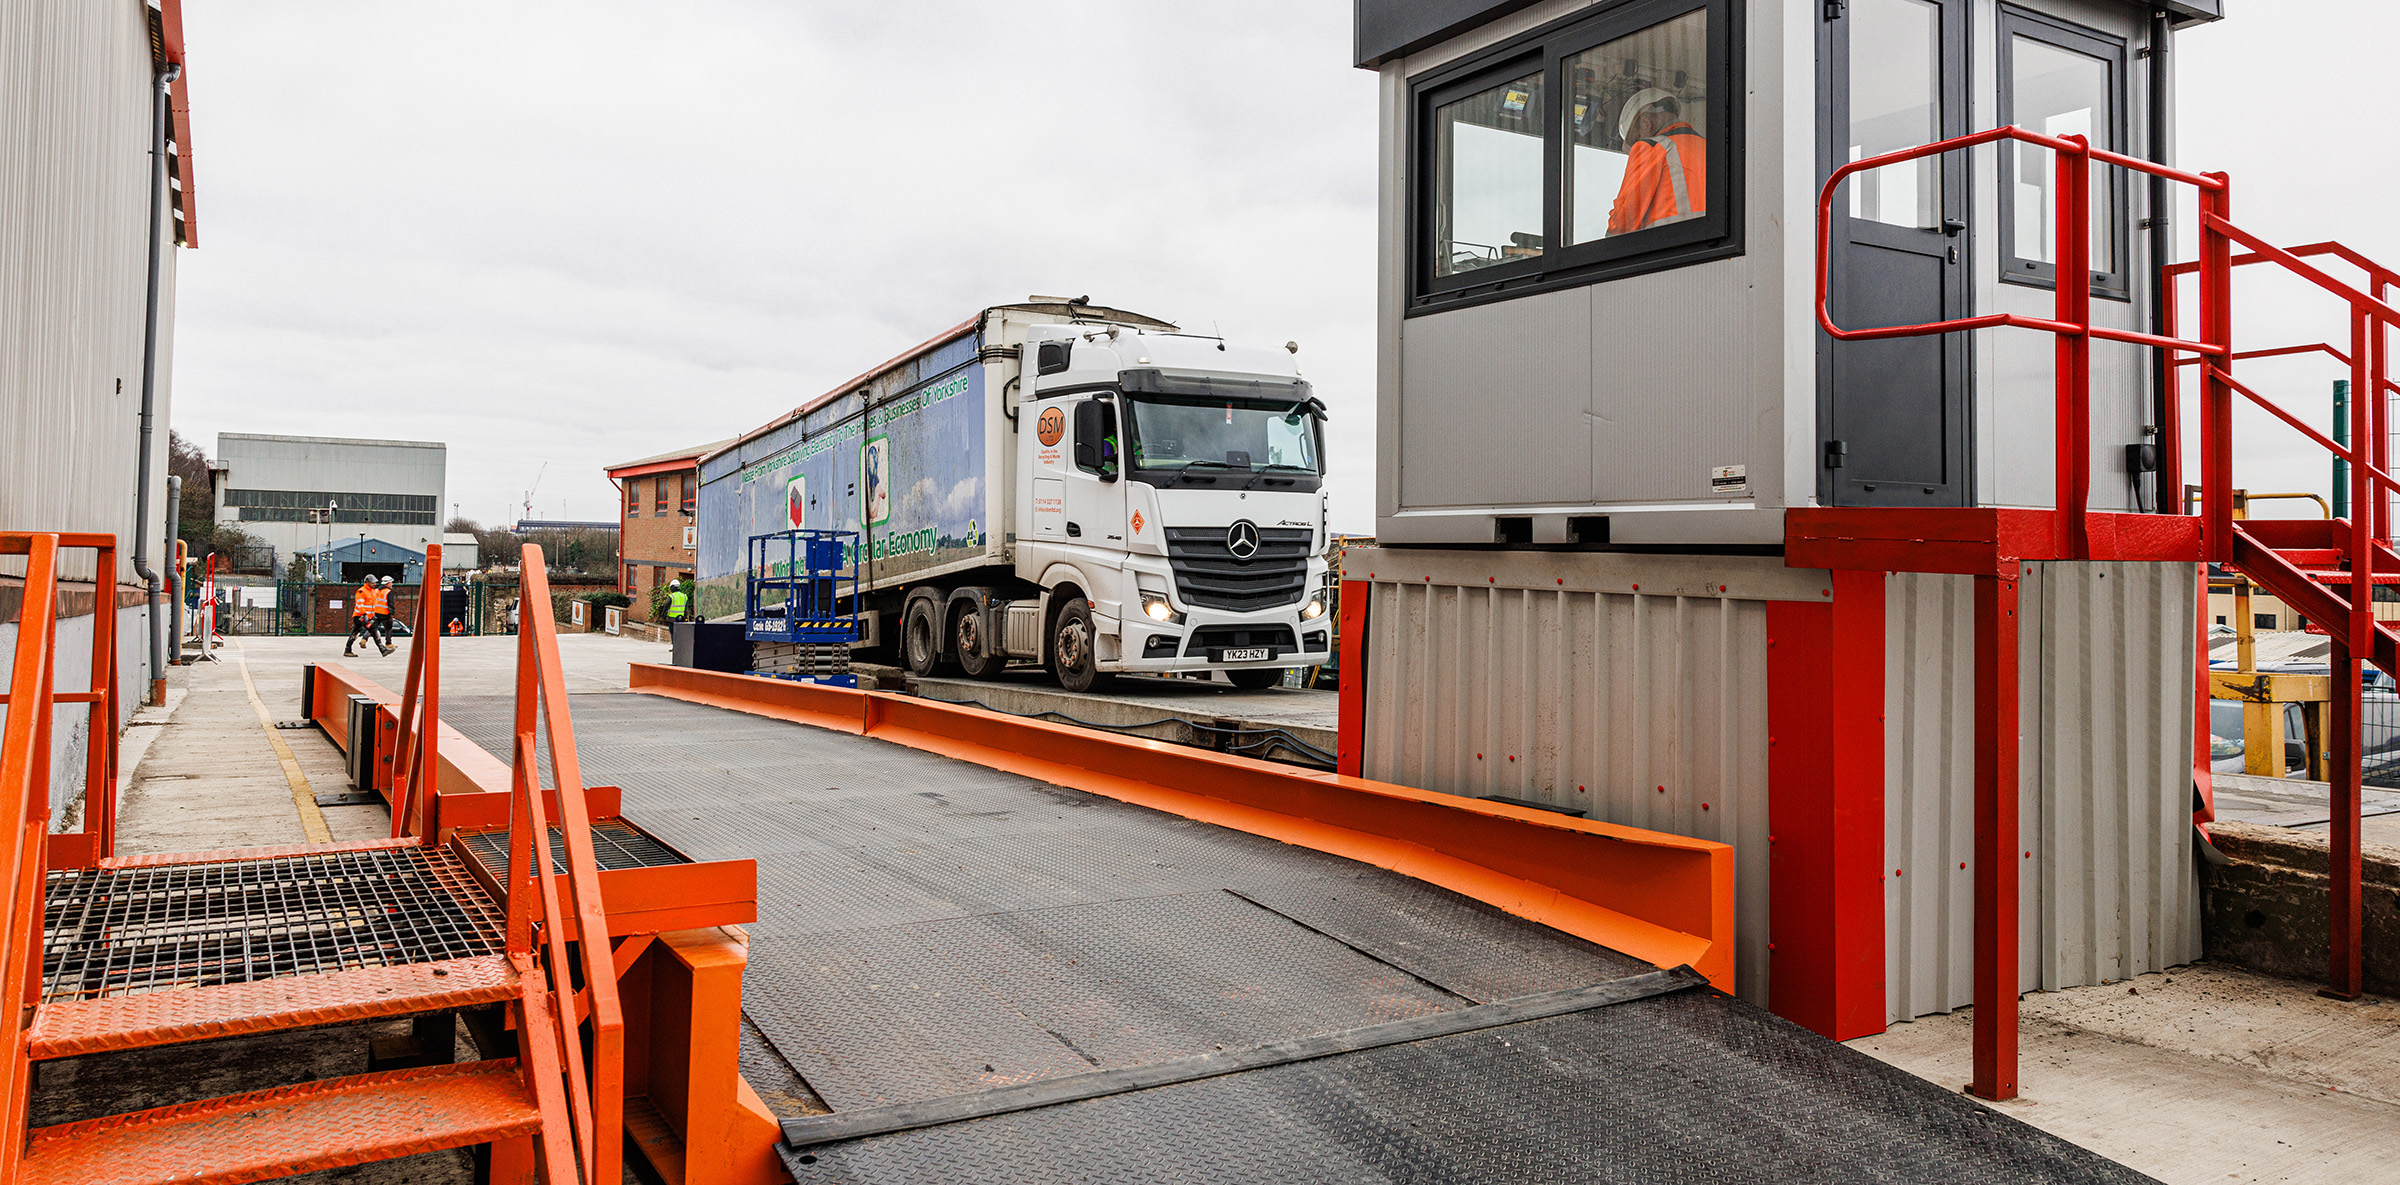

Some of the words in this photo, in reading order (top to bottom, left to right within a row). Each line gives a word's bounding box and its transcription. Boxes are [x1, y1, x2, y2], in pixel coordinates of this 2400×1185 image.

[754, 463, 766, 477] From
[767, 454, 788, 473] Yorkshire
[788, 444, 810, 465] Supplying
[811, 433, 837, 455] Electricity
[837, 428, 844, 442] To
[844, 424, 855, 440] The
[856, 416, 877, 434] Hoes
[878, 410, 883, 426] &
[884, 398, 920, 423] Businesses
[921, 386, 932, 408] Of
[933, 375, 968, 402] Yorkshire
[1039, 416, 1064, 434] DSM
[850, 533, 886, 564] Crclar
[888, 526, 938, 557] Economy
[1226, 650, 1248, 660] YK23
[1249, 649, 1266, 659] HZY
